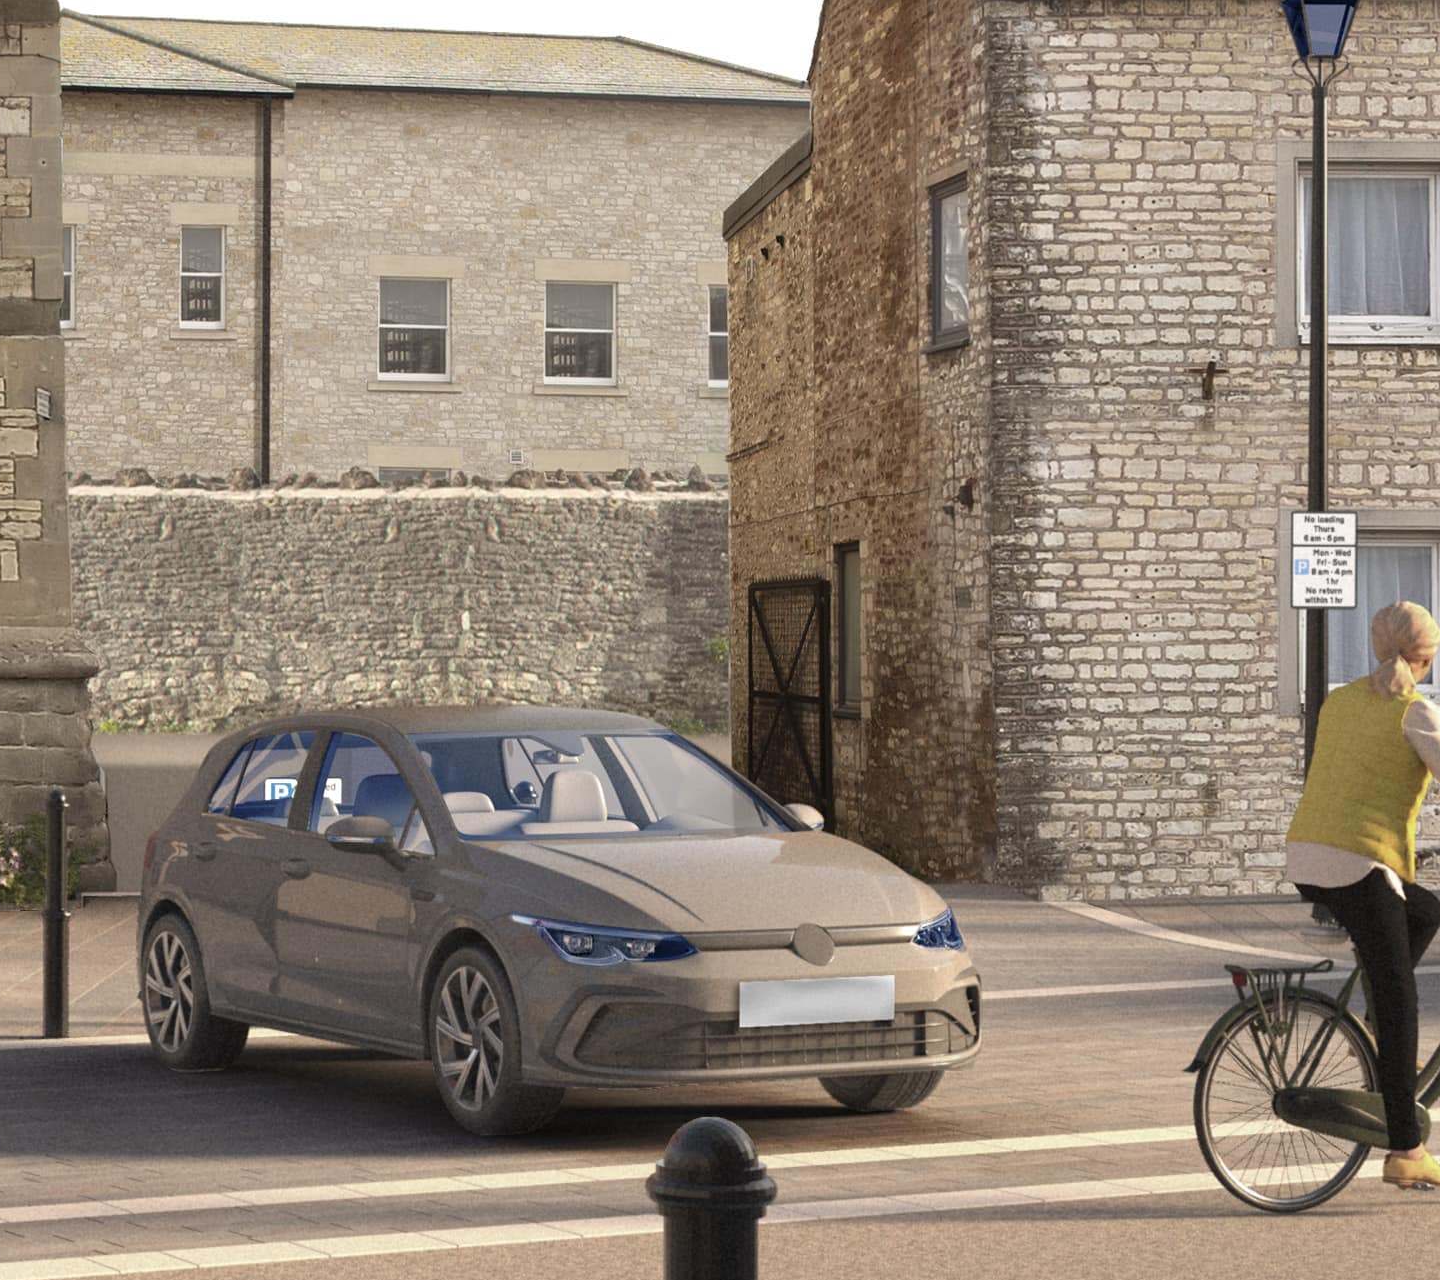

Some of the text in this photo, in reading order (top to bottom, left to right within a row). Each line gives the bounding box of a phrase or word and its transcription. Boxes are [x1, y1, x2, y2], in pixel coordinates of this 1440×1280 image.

[1317, 516, 1345, 525] loading
[1313, 549, 1329, 557] Mon
[1335, 549, 1352, 557] Wed
